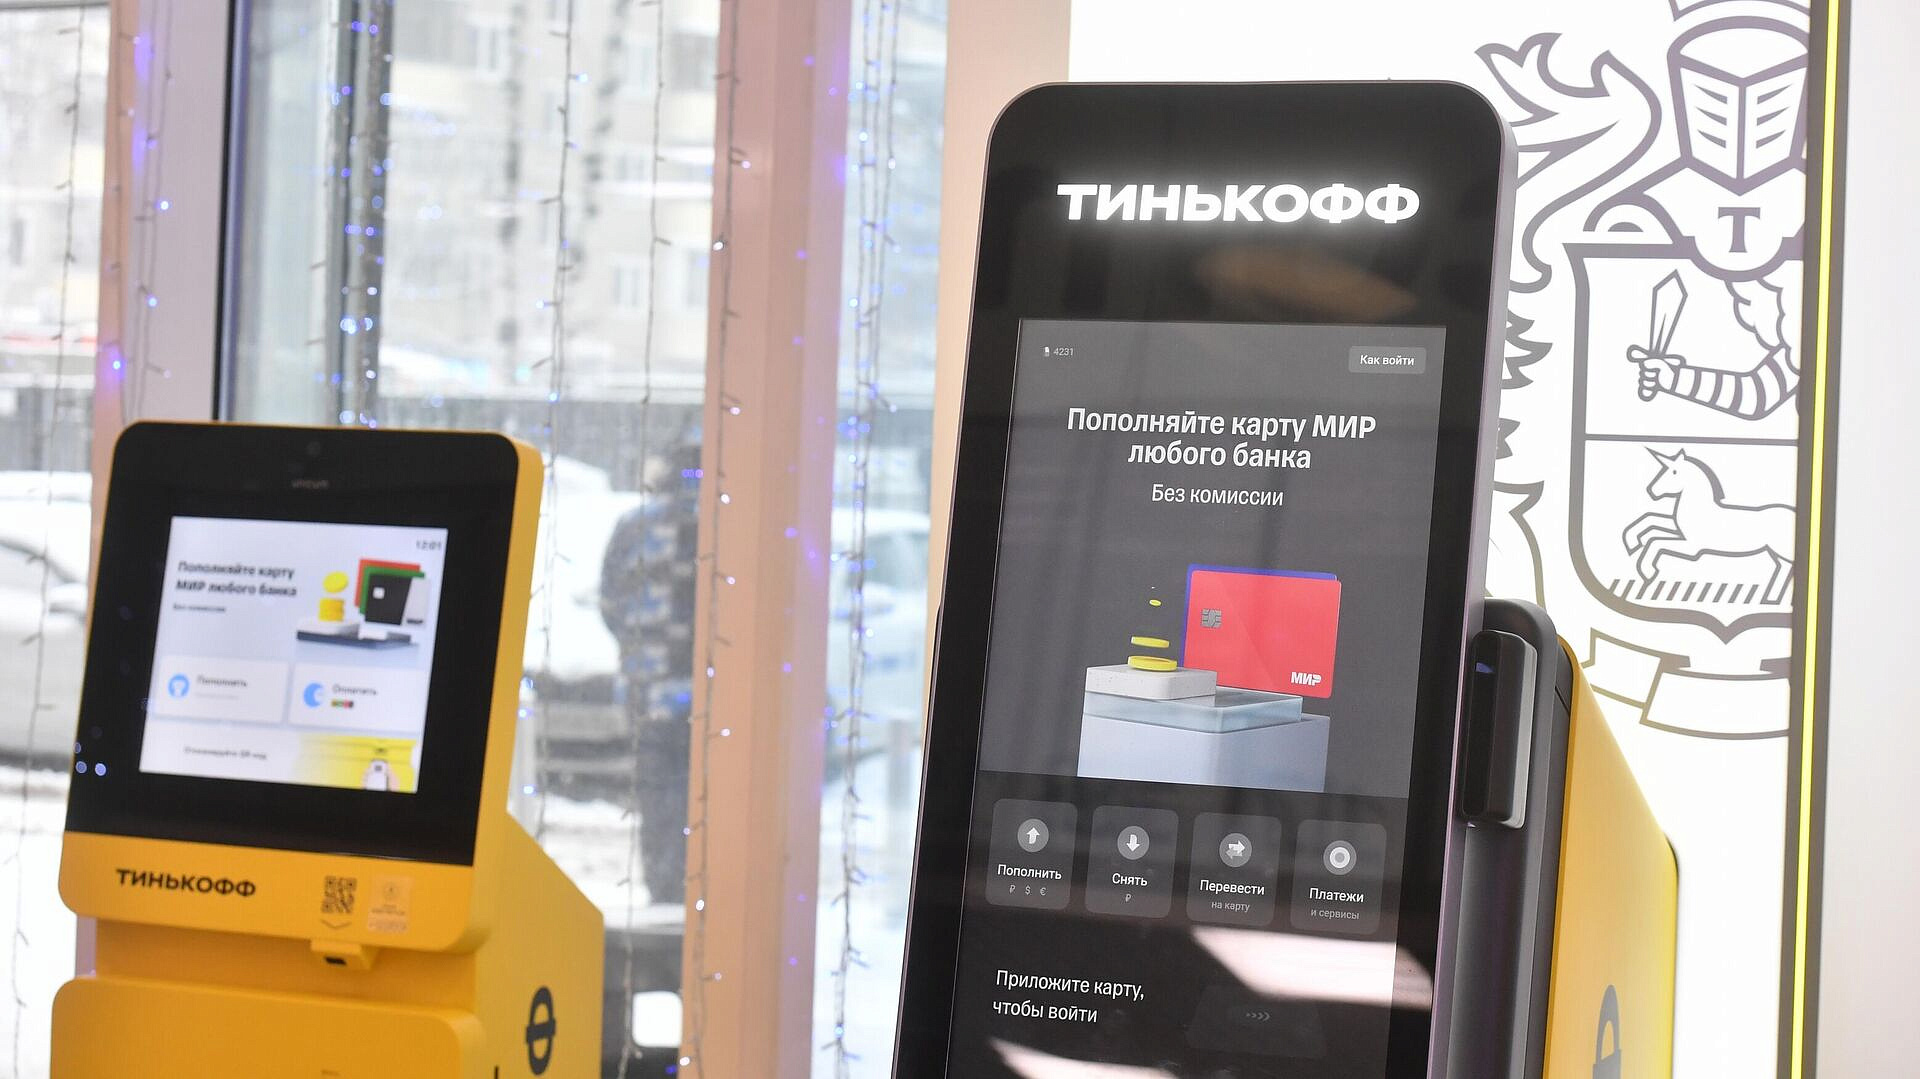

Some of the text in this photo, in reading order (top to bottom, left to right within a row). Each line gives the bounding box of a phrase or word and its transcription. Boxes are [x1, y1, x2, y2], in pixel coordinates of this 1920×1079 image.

[1056, 183, 1420, 224] ТИНЬКОФФ
[1053, 347, 1074, 356] 4231
[1360, 354, 1415, 366] Как войти
[1067, 407, 1377, 442] Пополняйте карту МИР
[1127, 440, 1312, 469] любого банка
[1151, 483, 1285, 507] Без комиссии
[1290, 671, 1323, 687] МИР
[997, 864, 1063, 880] Пополнить
[1112, 872, 1148, 887] Снять
[116, 868, 257, 897] ТИНЬКОФФ
[1200, 879, 1265, 896] Перевести
[1309, 887, 1365, 903] Платежи
[1211, 901, 1250, 914] на карту
[1318, 910, 1360, 920] сервисы
[996, 969, 1145, 1002] Приложите карту,
[992, 1000, 1098, 1023] чтобы войти
